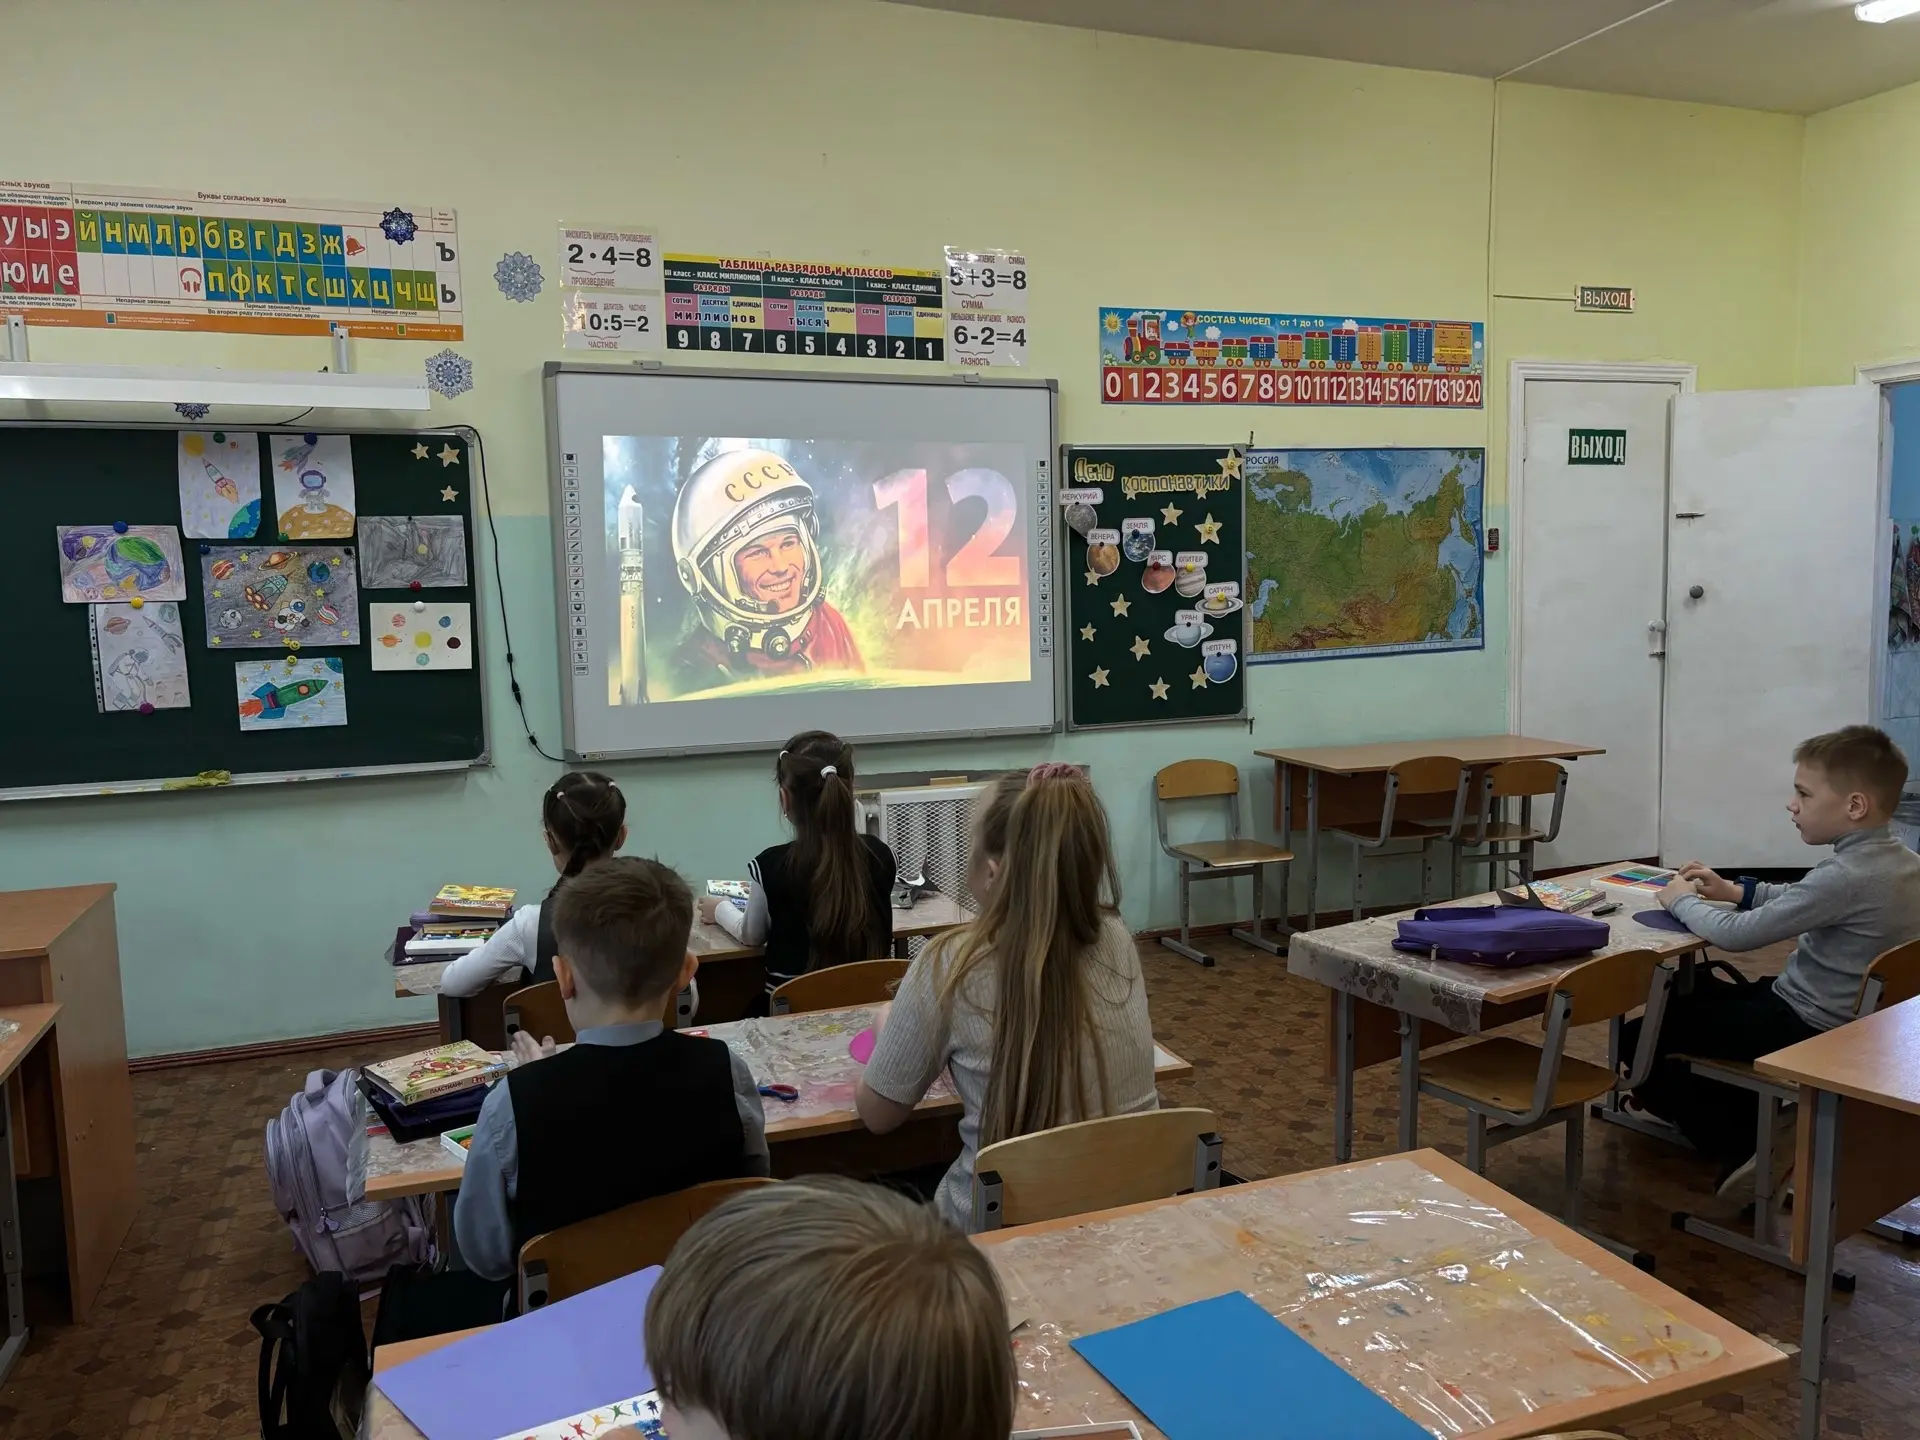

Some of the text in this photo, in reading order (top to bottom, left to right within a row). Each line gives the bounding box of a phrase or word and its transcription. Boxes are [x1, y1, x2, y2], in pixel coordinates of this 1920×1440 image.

[198, 192, 287, 204] Буквы согласных звуков
[25, 217, 48, 239] ы
[55, 219, 70, 240] э
[204, 221, 221, 249] б
[1008, 256, 1026, 265] СУММА
[719, 259, 893, 279] ТАБЛИЦА РАЗРЯДОВ И КЛАССОВ
[571, 276, 615, 287] ПРОИЗВЕДЕНИЕ
[719, 273, 761, 281] МИЛЛИОНОВ
[821, 278, 843, 286] ТЫСЯЧ
[230, 267, 251, 300] ф
[693, 283, 731, 293] РАЗРЯДЫ
[891, 283, 911, 291] КЛАСС
[911, 284, 937, 293] ЕДИНИЦ
[790, 289, 826, 299] РАЗРЯДЫ
[882, 294, 917, 304] РАЗРЯДЫ
[701, 299, 728, 307] ДЕСЯТКИ
[732, 301, 762, 309] ЕДИНИЦЫ
[961, 300, 984, 309] СУММА
[1584, 291, 1627, 308] ВЫХОД
[1197, 314, 1237, 324] СОСТАВ
[1239, 317, 1271, 326] ЧИСЕЛ
[1292, 318, 1297, 327] 1
[1300, 320, 1311, 328] до
[1313, 319, 1325, 328] 10
[588, 340, 619, 349] ЧАСТНОЕ
[678, 329, 753, 351] 9 8 7
[776, 334, 847, 355] 6 5 4
[866, 338, 933, 359] 3 2 1
[960, 357, 990, 366] РАЗНОСТЬ
[1105, 372, 1481, 403] 0 1 2 3 4 5 6 7 8 9 10 11 12 13 14 15 16 17 18 19 20
[1571, 435, 1625, 463] ВЫХОД
[1246, 456, 1279, 465] РОССИЯ
[1061, 491, 1098, 501] МЕРКУРИЙ
[873, 468, 1020, 588] 12
[1126, 521, 1149, 530] ЗЕМЛЯ
[1090, 533, 1115, 541] ВЕНЕРА
[896, 597, 1021, 630] АПРЕЛЯ
[1206, 643, 1232, 652] НЕПТУН
